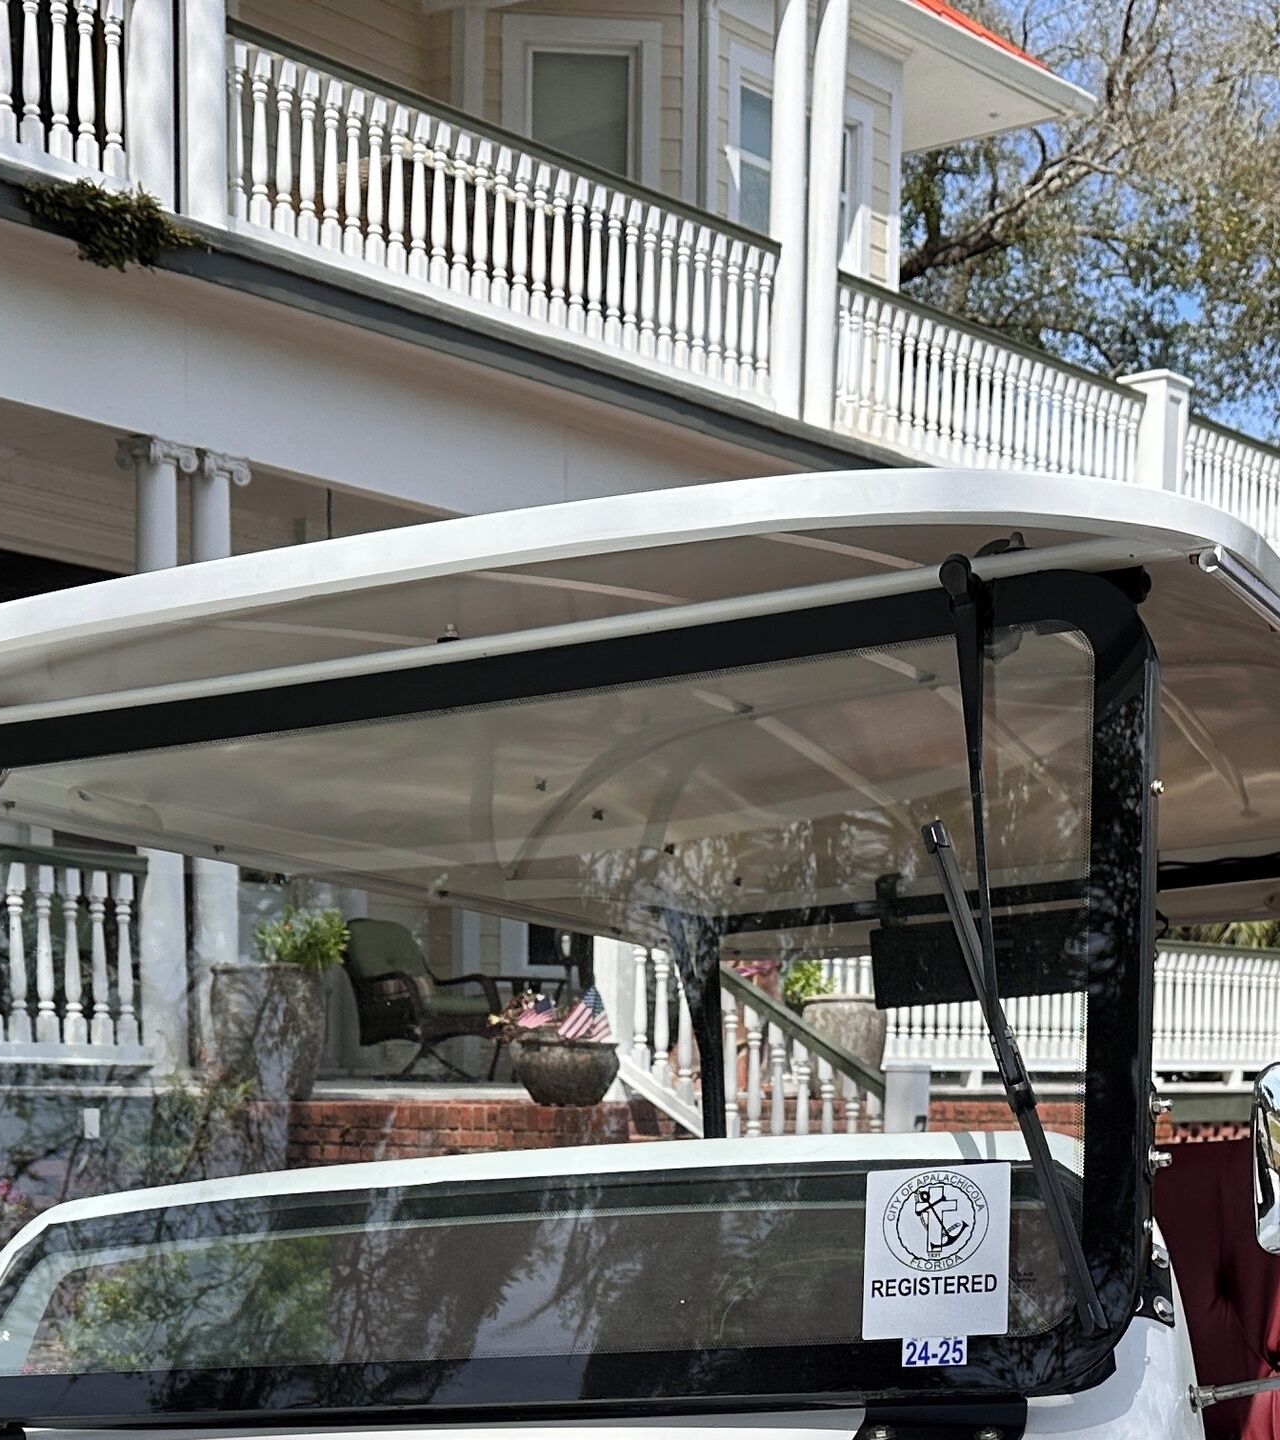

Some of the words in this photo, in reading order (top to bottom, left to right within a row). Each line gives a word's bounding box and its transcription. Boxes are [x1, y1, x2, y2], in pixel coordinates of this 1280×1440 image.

[887, 1200, 900, 1222] CITY
[901, 1183, 915, 1198] OF
[916, 1173, 986, 1212] APALACHICOLA
[909, 1254, 963, 1270] FLORIDA
[871, 1273, 998, 1298] REGISTERED
[905, 1341, 964, 1366] 24-25
